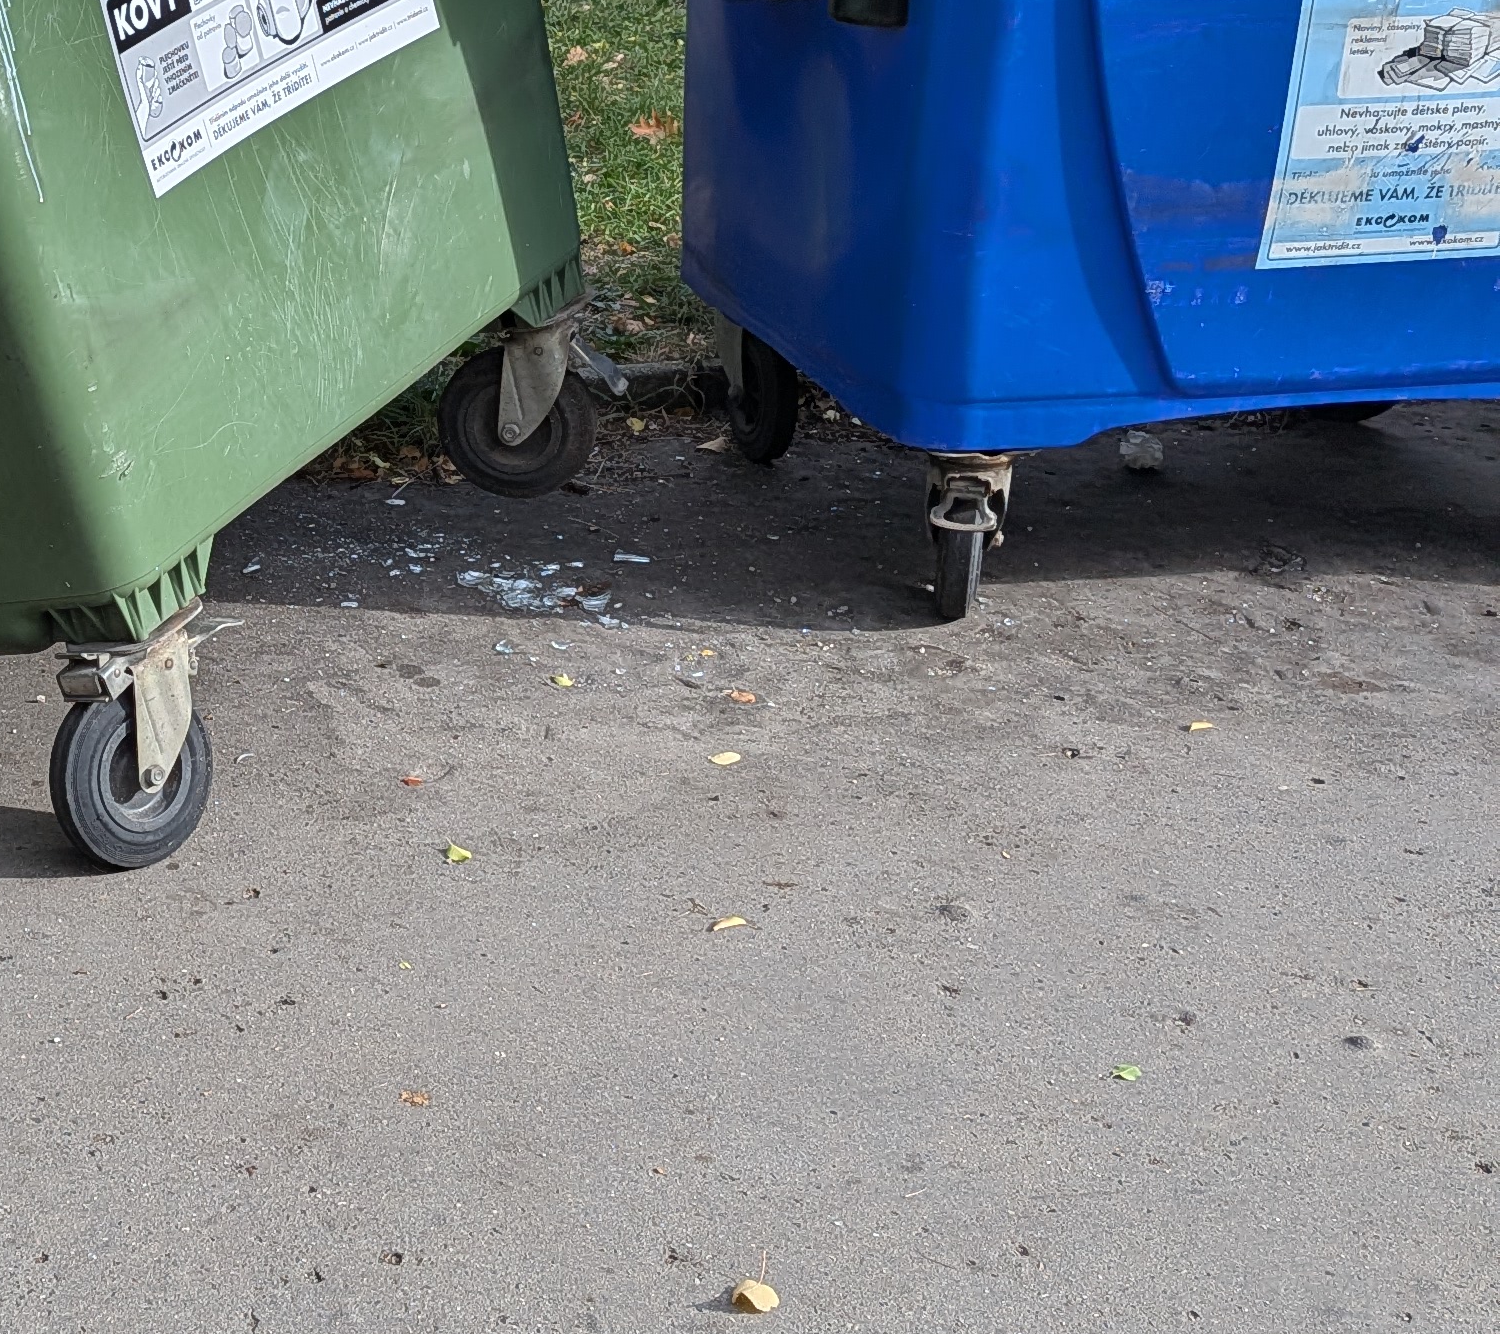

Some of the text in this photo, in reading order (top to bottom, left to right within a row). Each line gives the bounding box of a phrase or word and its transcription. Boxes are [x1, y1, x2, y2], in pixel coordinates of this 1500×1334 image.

[1352, 23, 1384, 33] Noviny,
[212, 109, 251, 141] DĚKUJEME
[271, 90, 282, 105] ŽE
[282, 73, 313, 98] TŘÍDÍTE!
[1340, 102, 1486, 119] Nevhazujte dětské pleny,
[1317, 125, 1361, 137] uhlový,
[1364, 120, 1414, 136] voskový,
[1418, 120, 1457, 136] mokrý,
[1361, 139, 1390, 154] jinak
[1455, 137, 1489, 151] papír.
[1379, 184, 1420, 203] VÁM,
[1424, 182, 1445, 200] ŽE
[1285, 242, 1362, 255] www.jaktridit.cz
